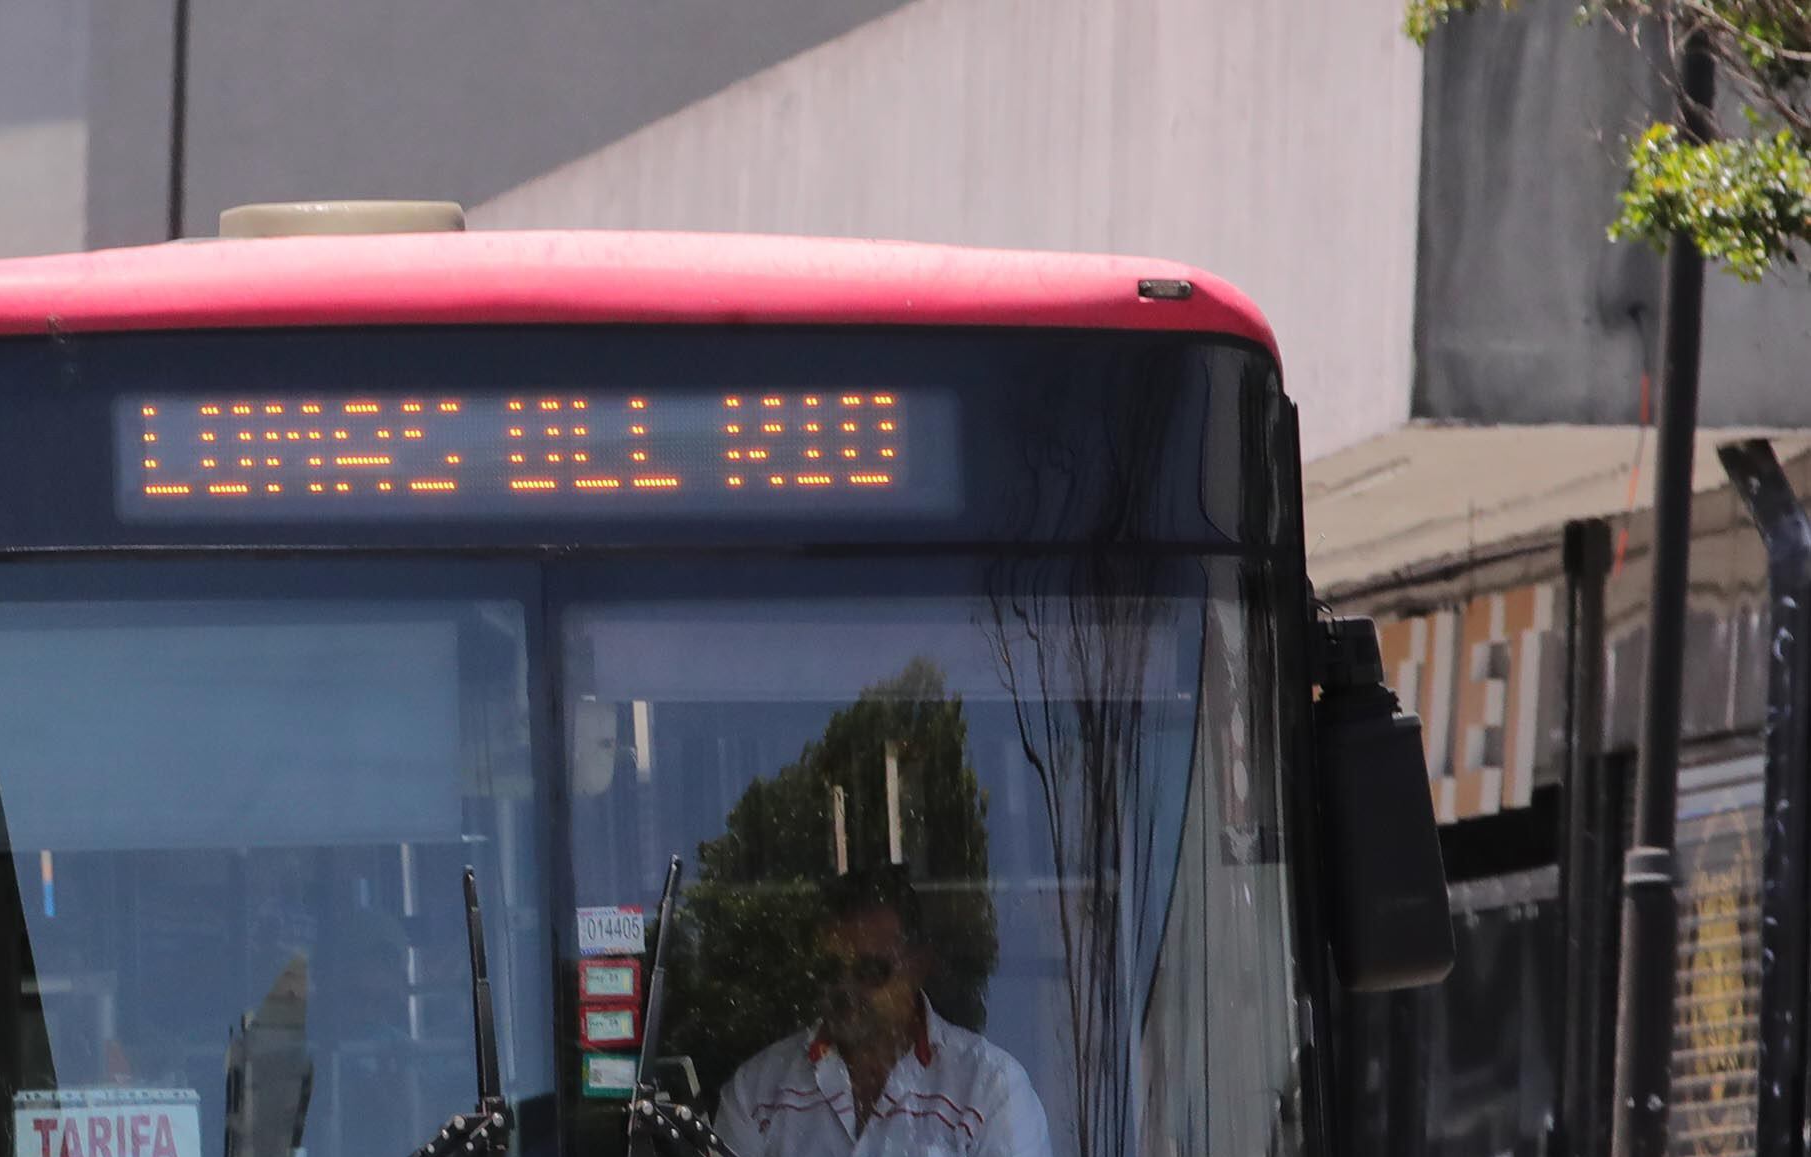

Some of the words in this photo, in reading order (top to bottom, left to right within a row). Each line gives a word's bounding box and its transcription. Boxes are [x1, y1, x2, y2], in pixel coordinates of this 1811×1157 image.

[142, 400, 459, 495] LOMAS
[508, 398, 678, 491] DEL
[726, 394, 894, 488] RIO
[587, 916, 641, 941] 014405
